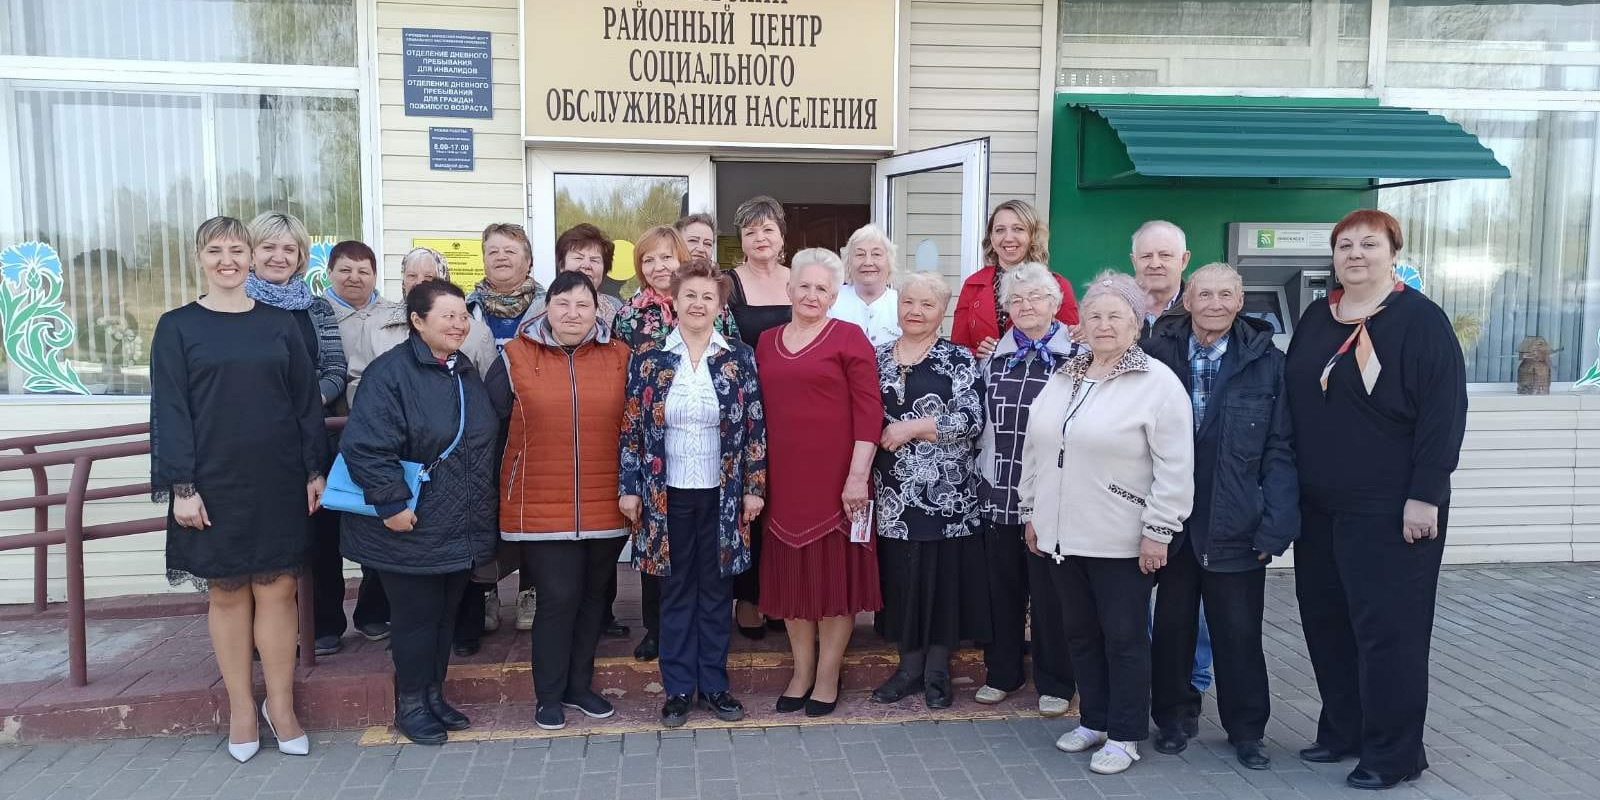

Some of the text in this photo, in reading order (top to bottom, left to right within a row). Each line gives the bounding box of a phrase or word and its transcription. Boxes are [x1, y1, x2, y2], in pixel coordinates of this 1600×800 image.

[602, 1, 823, 52] РАЙОННЫЙ ЦЕНТР
[406, 50, 488, 59] ОТДЕЛЕНИЕ ДНЕВНОГО
[423, 58, 472, 66] ПРЕБЫВАНИЯ
[434, 66, 478, 74] ИНВАЛИДОВ
[629, 48, 795, 88] СОЦИАЛЬНОГО
[451, 81, 489, 89] ДНЕВНОГО
[440, 96, 474, 104] ГРАЖДАН
[451, 104, 488, 112] ВОЗРАСТА
[546, 87, 877, 130] ОБСЛУЖИВАНИЯ НАСЕЛЕНИЯ
[433, 143, 469, 151] 8.00-17.00
